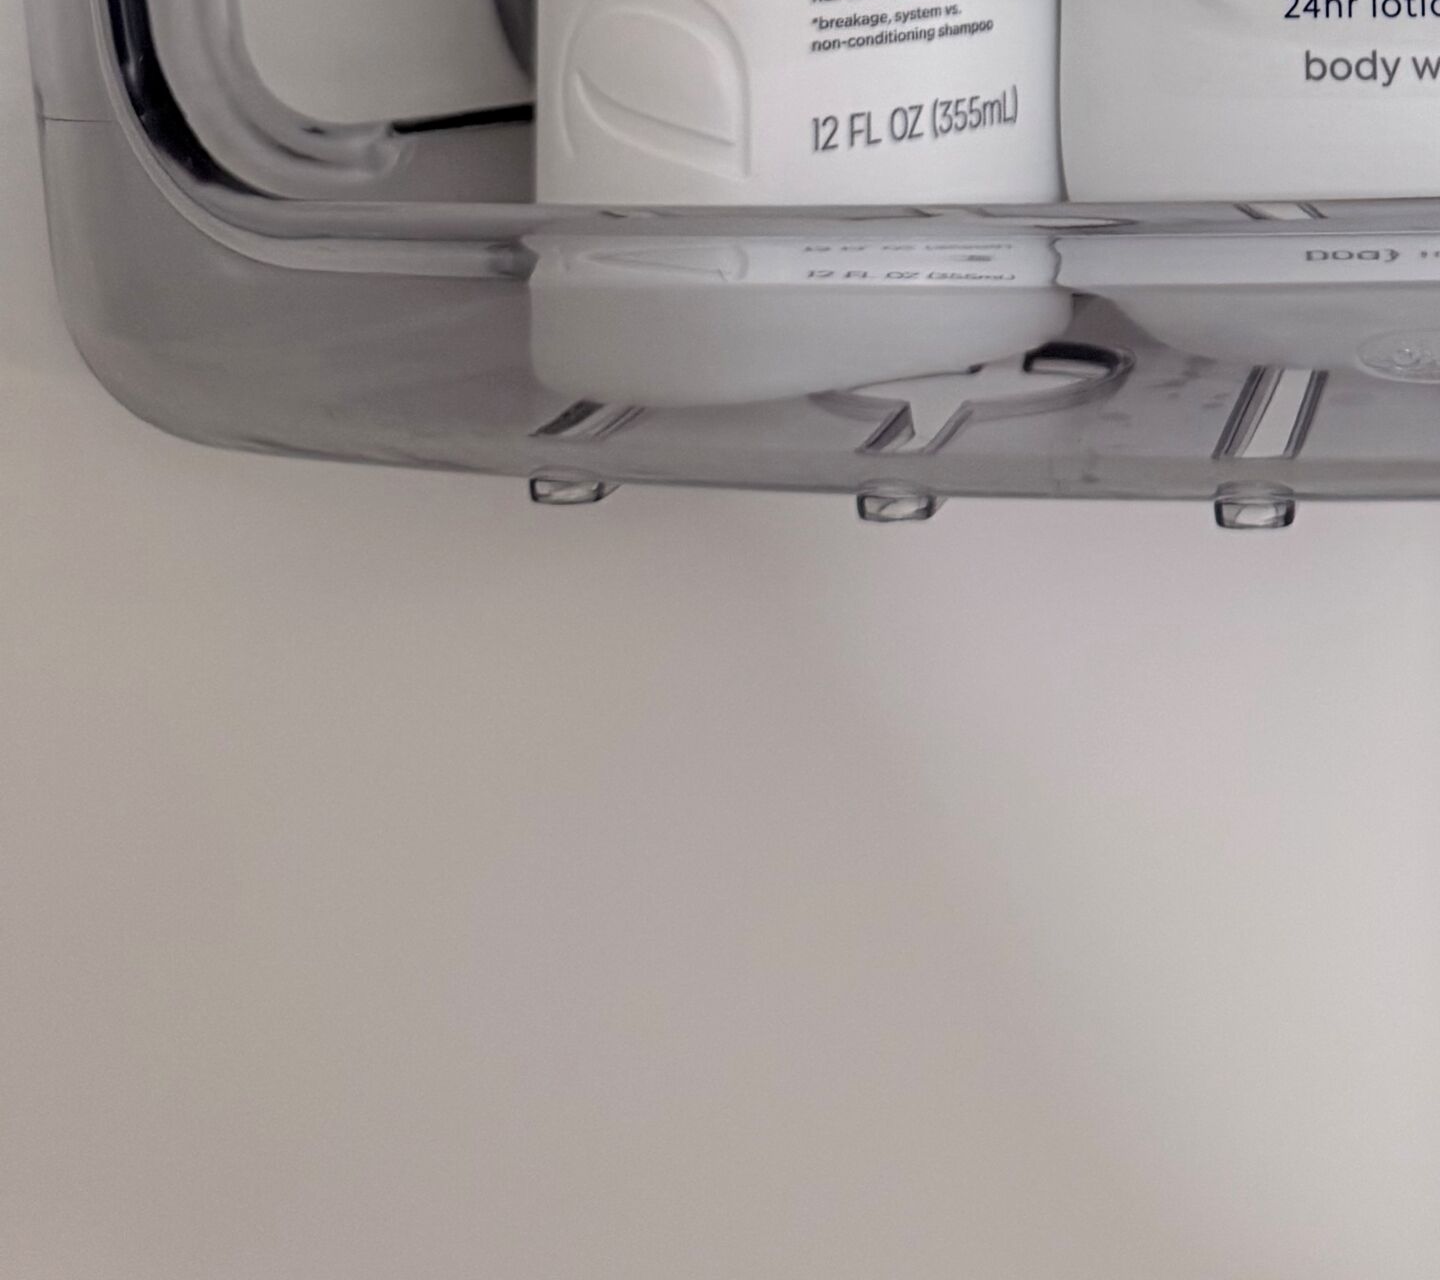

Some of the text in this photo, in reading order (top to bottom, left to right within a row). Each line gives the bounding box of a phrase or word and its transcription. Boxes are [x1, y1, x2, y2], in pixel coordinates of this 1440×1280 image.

[894, 5, 942, 23] system
[944, 3, 963, 16] vs.
[810, 19, 994, 53] non-conditioning shampoo
[1305, 49, 1401, 87] body
[811, 84, 1018, 153] 12 FL OZ (355mL)
